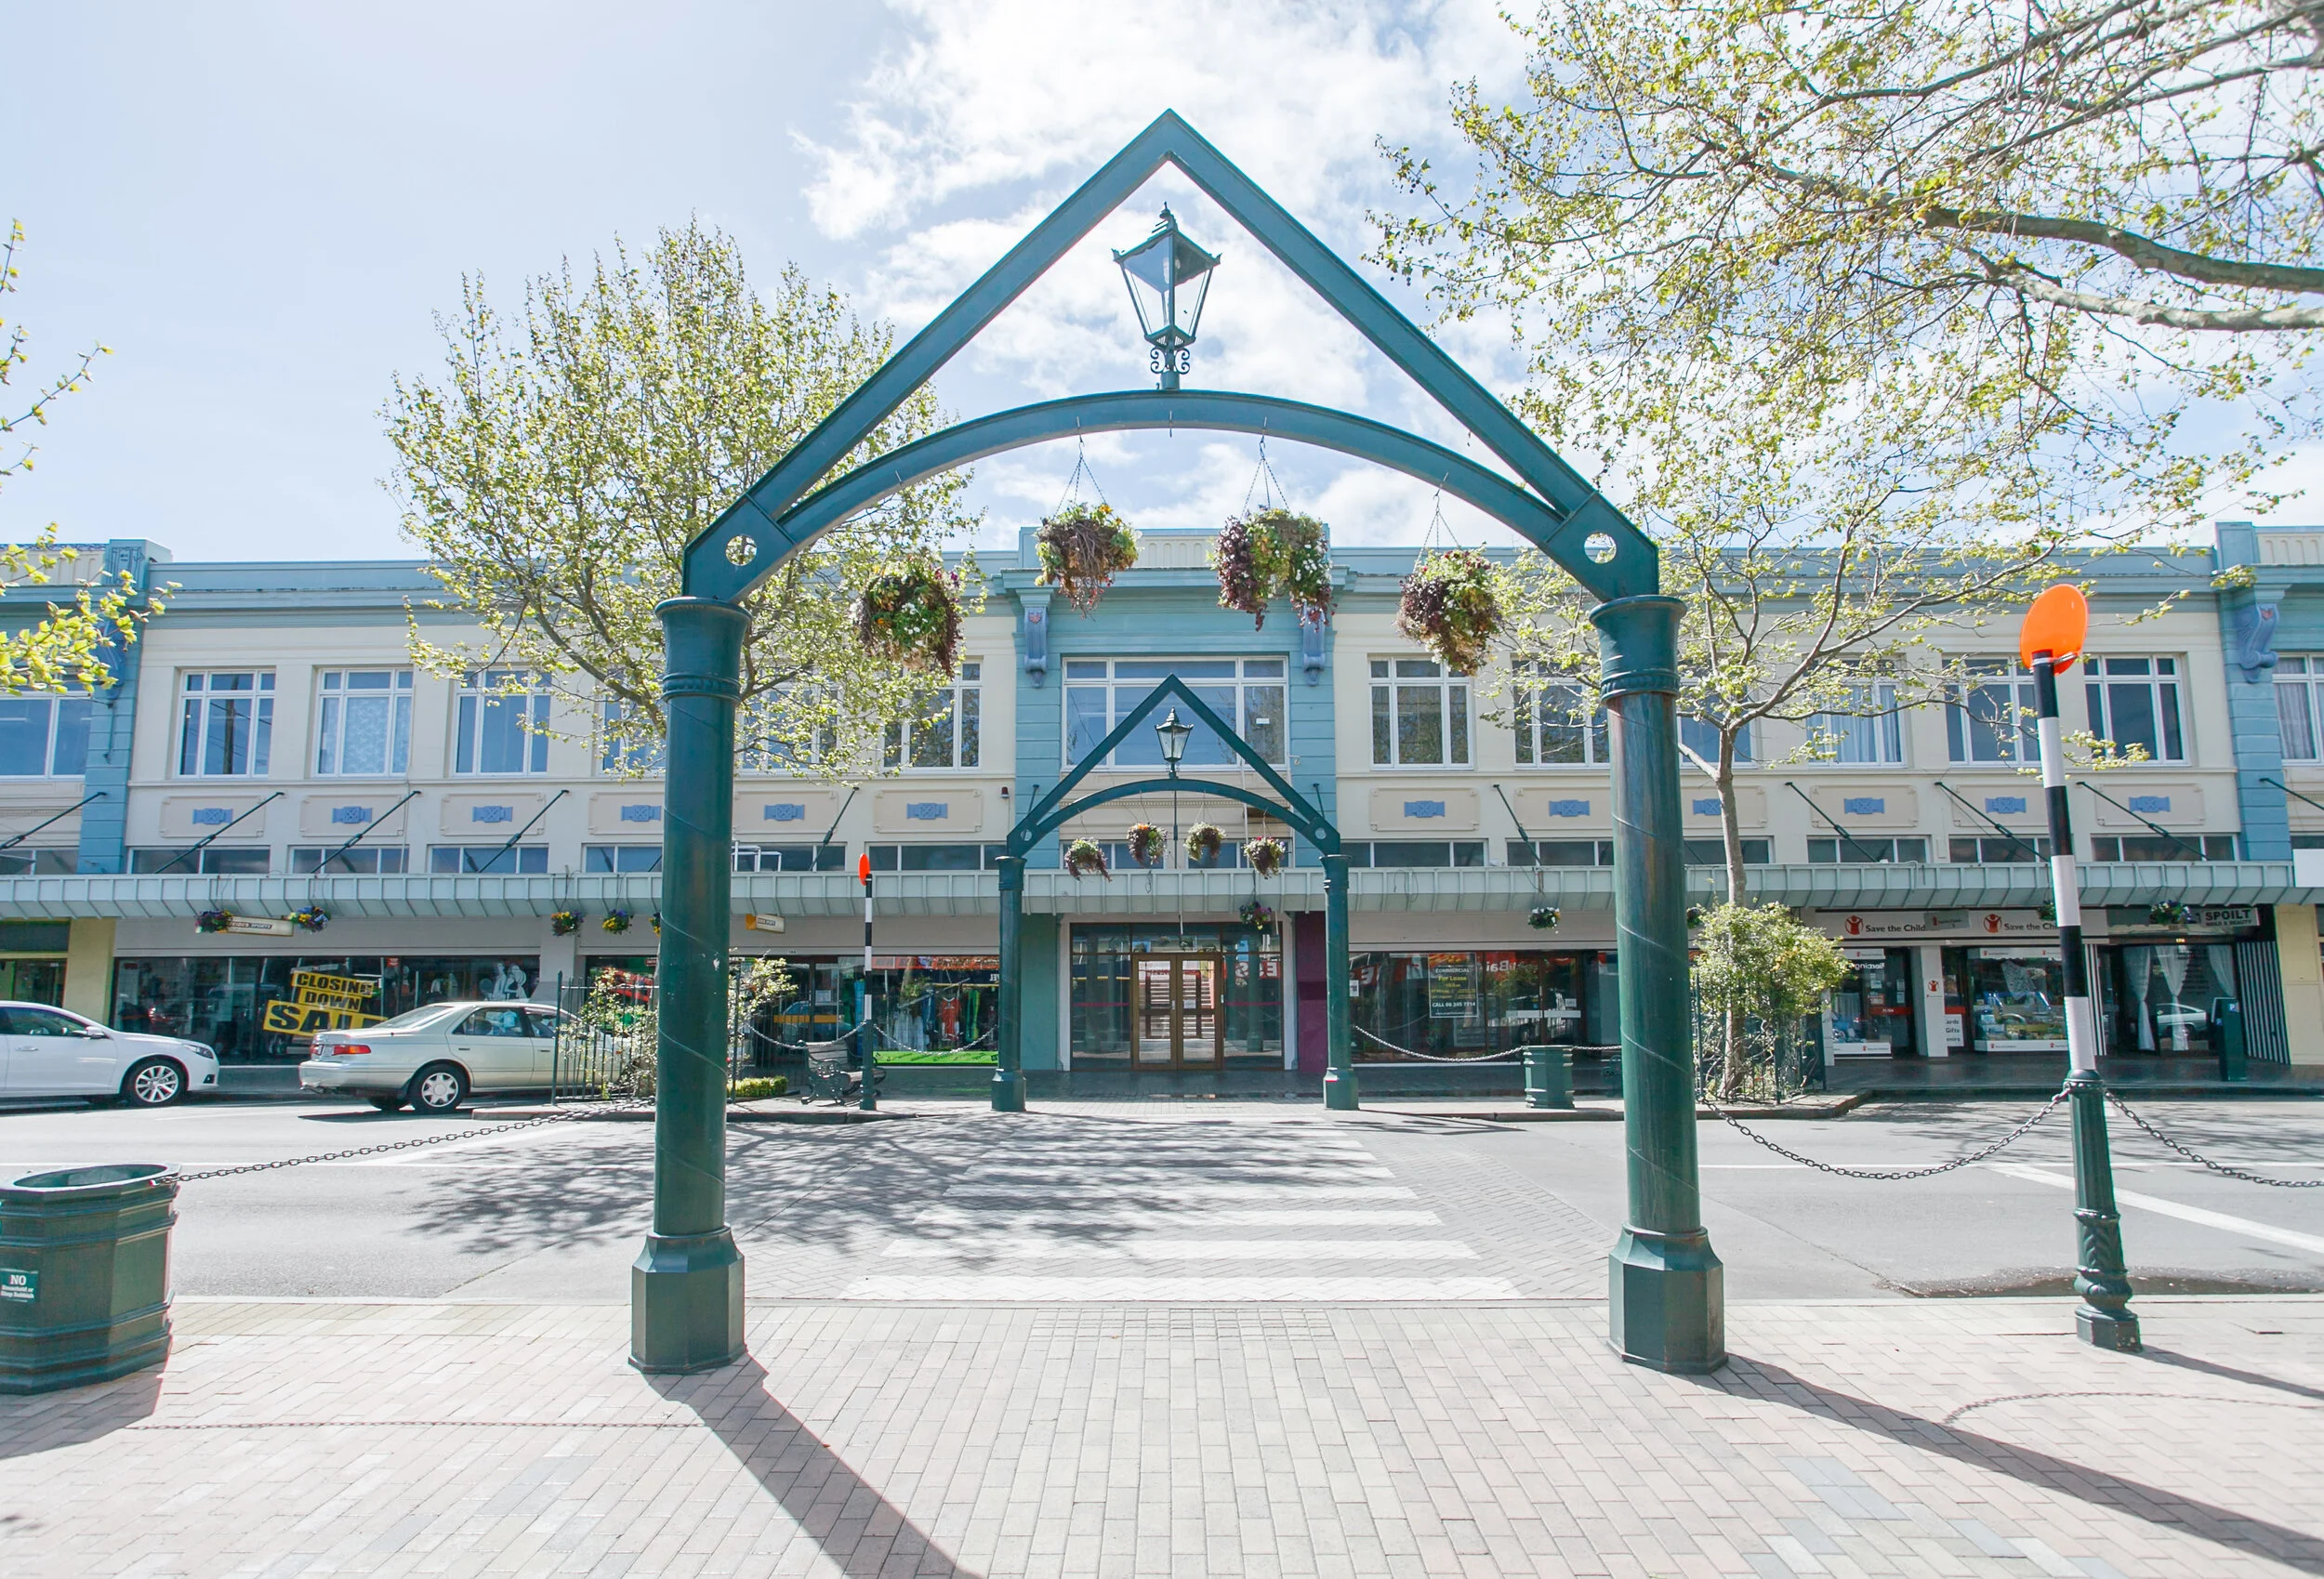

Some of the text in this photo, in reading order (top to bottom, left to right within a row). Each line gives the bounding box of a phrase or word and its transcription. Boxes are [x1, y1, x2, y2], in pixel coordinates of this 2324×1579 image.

[2205, 910, 2250, 920] SPOILT
[1865, 925, 1885, 933] Save
[1890, 924, 1902, 932] the
[2026, 922, 2040, 930] the
[297, 973, 372, 995] CLOSING
[305, 991, 360, 1011] DOWN
[9, 1274, 26, 1285] NO
